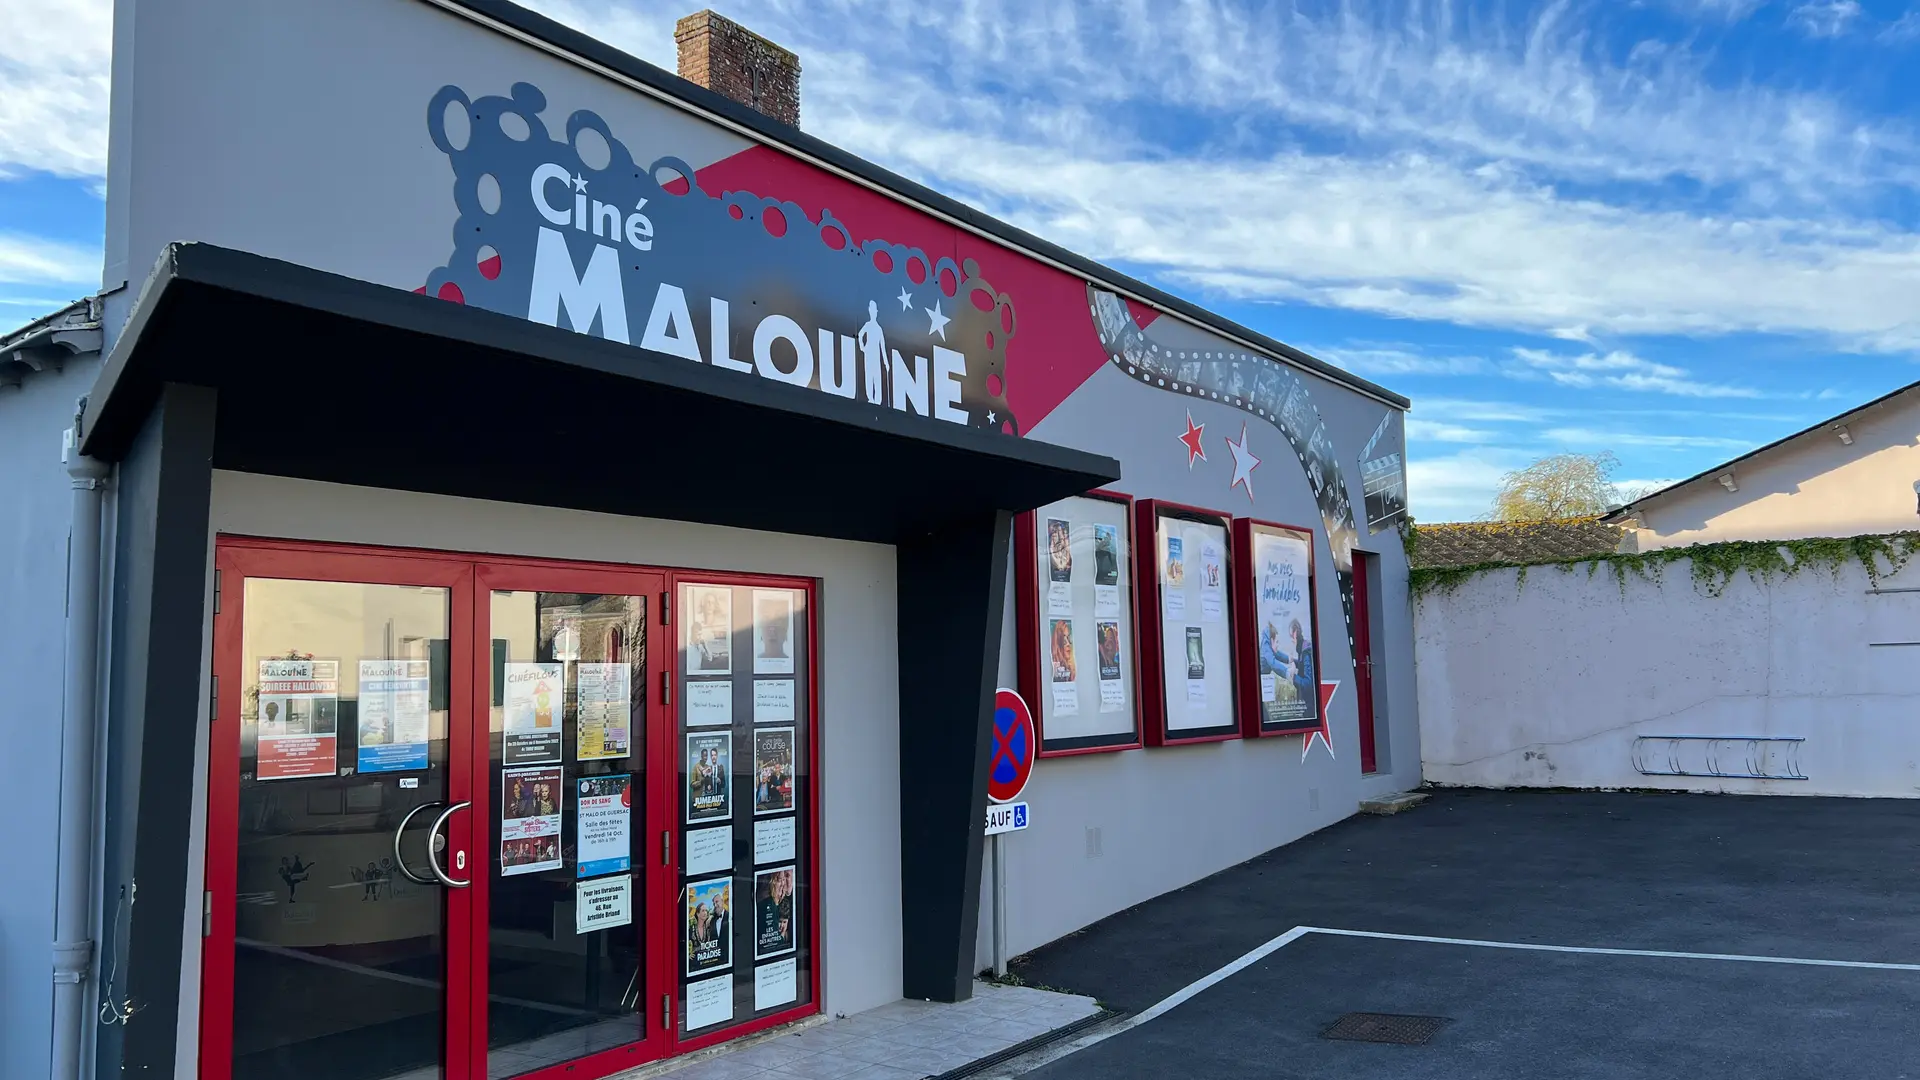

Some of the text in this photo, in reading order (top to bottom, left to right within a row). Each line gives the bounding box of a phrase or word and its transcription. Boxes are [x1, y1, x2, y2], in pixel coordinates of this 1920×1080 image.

[530, 163, 653, 251] Ciné
[762, 742, 786, 750] course
[693, 794, 724, 806] JUMEAUX
[607, 808, 629, 816] GUERSAC
[587, 913, 604, 921] Aristide
[701, 939, 718, 950] TICKET
[697, 948, 721, 961] PARADISE
